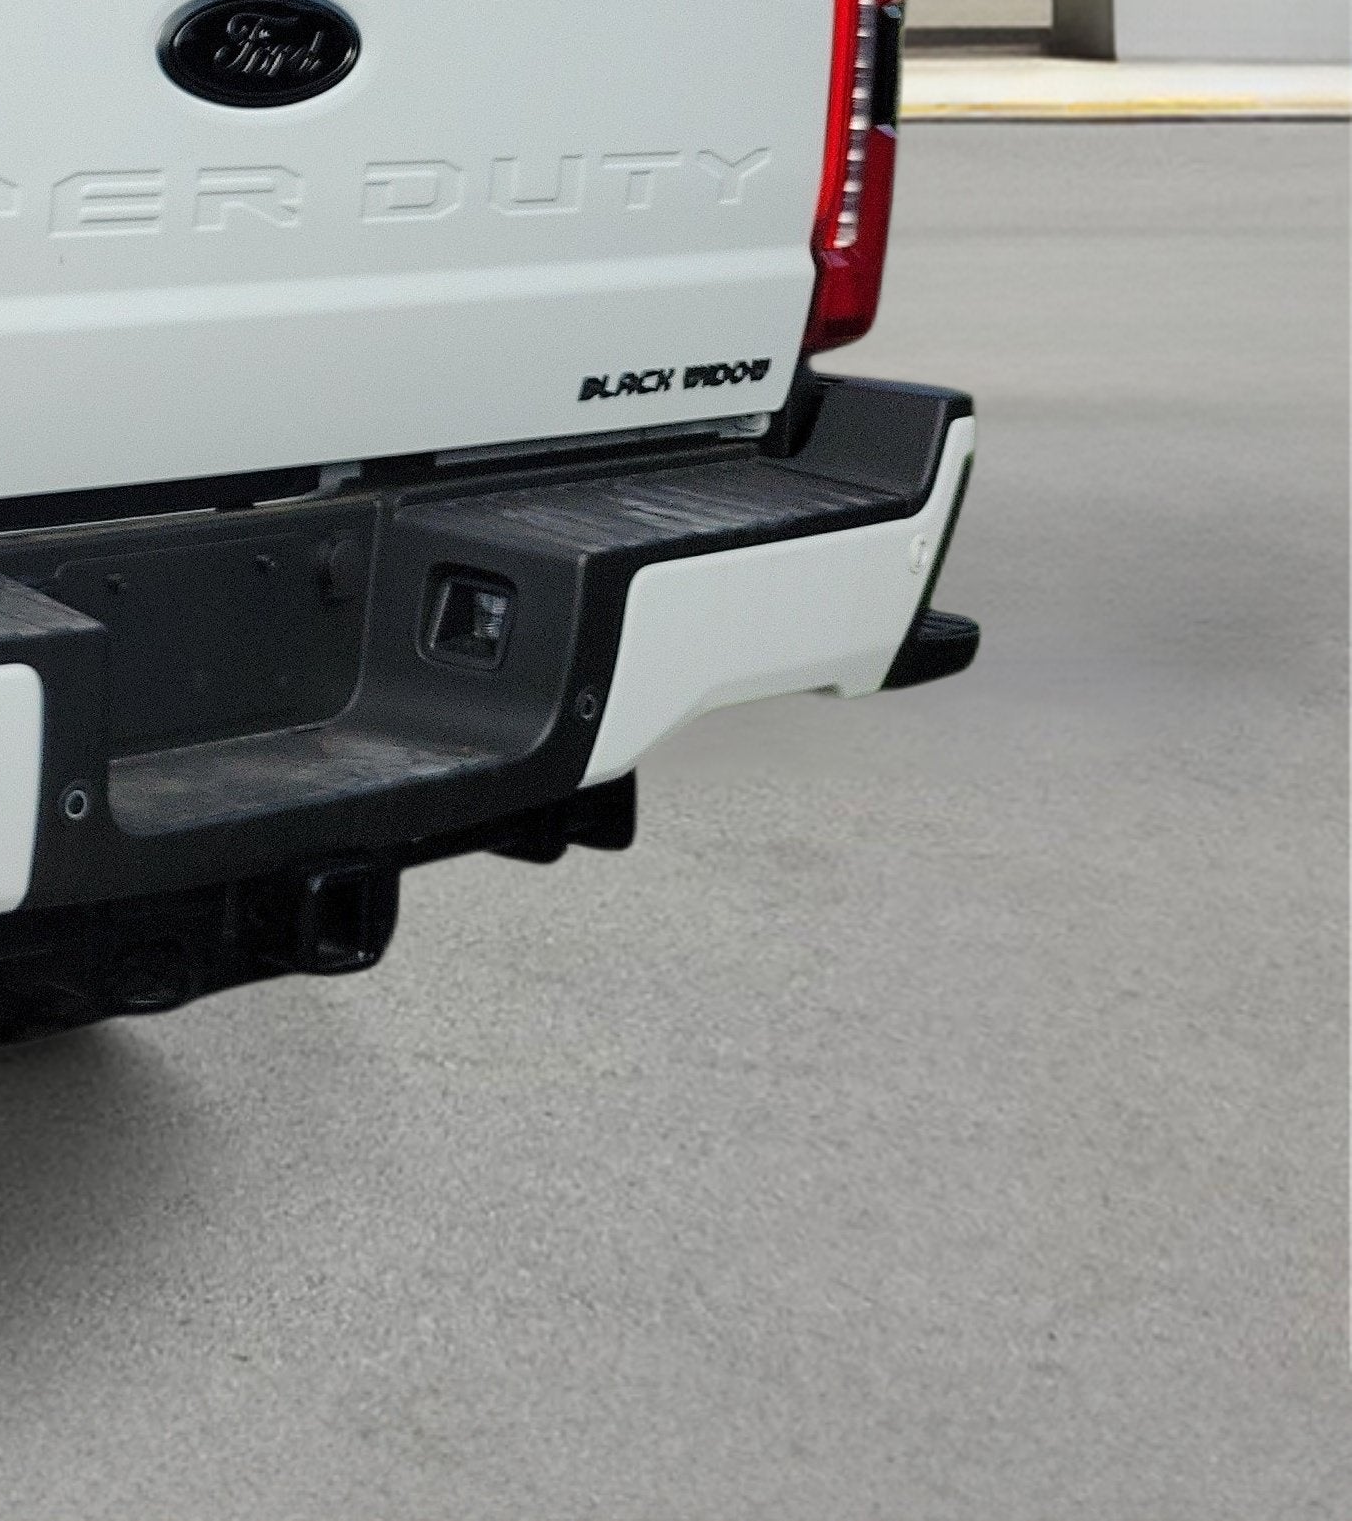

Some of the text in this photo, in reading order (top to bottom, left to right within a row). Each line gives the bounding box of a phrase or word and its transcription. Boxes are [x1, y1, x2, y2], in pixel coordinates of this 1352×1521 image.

[213, 12, 323, 78] Ford
[360, 145, 772, 224] DUTY
[577, 357, 772, 401] BLACK WIDOW
